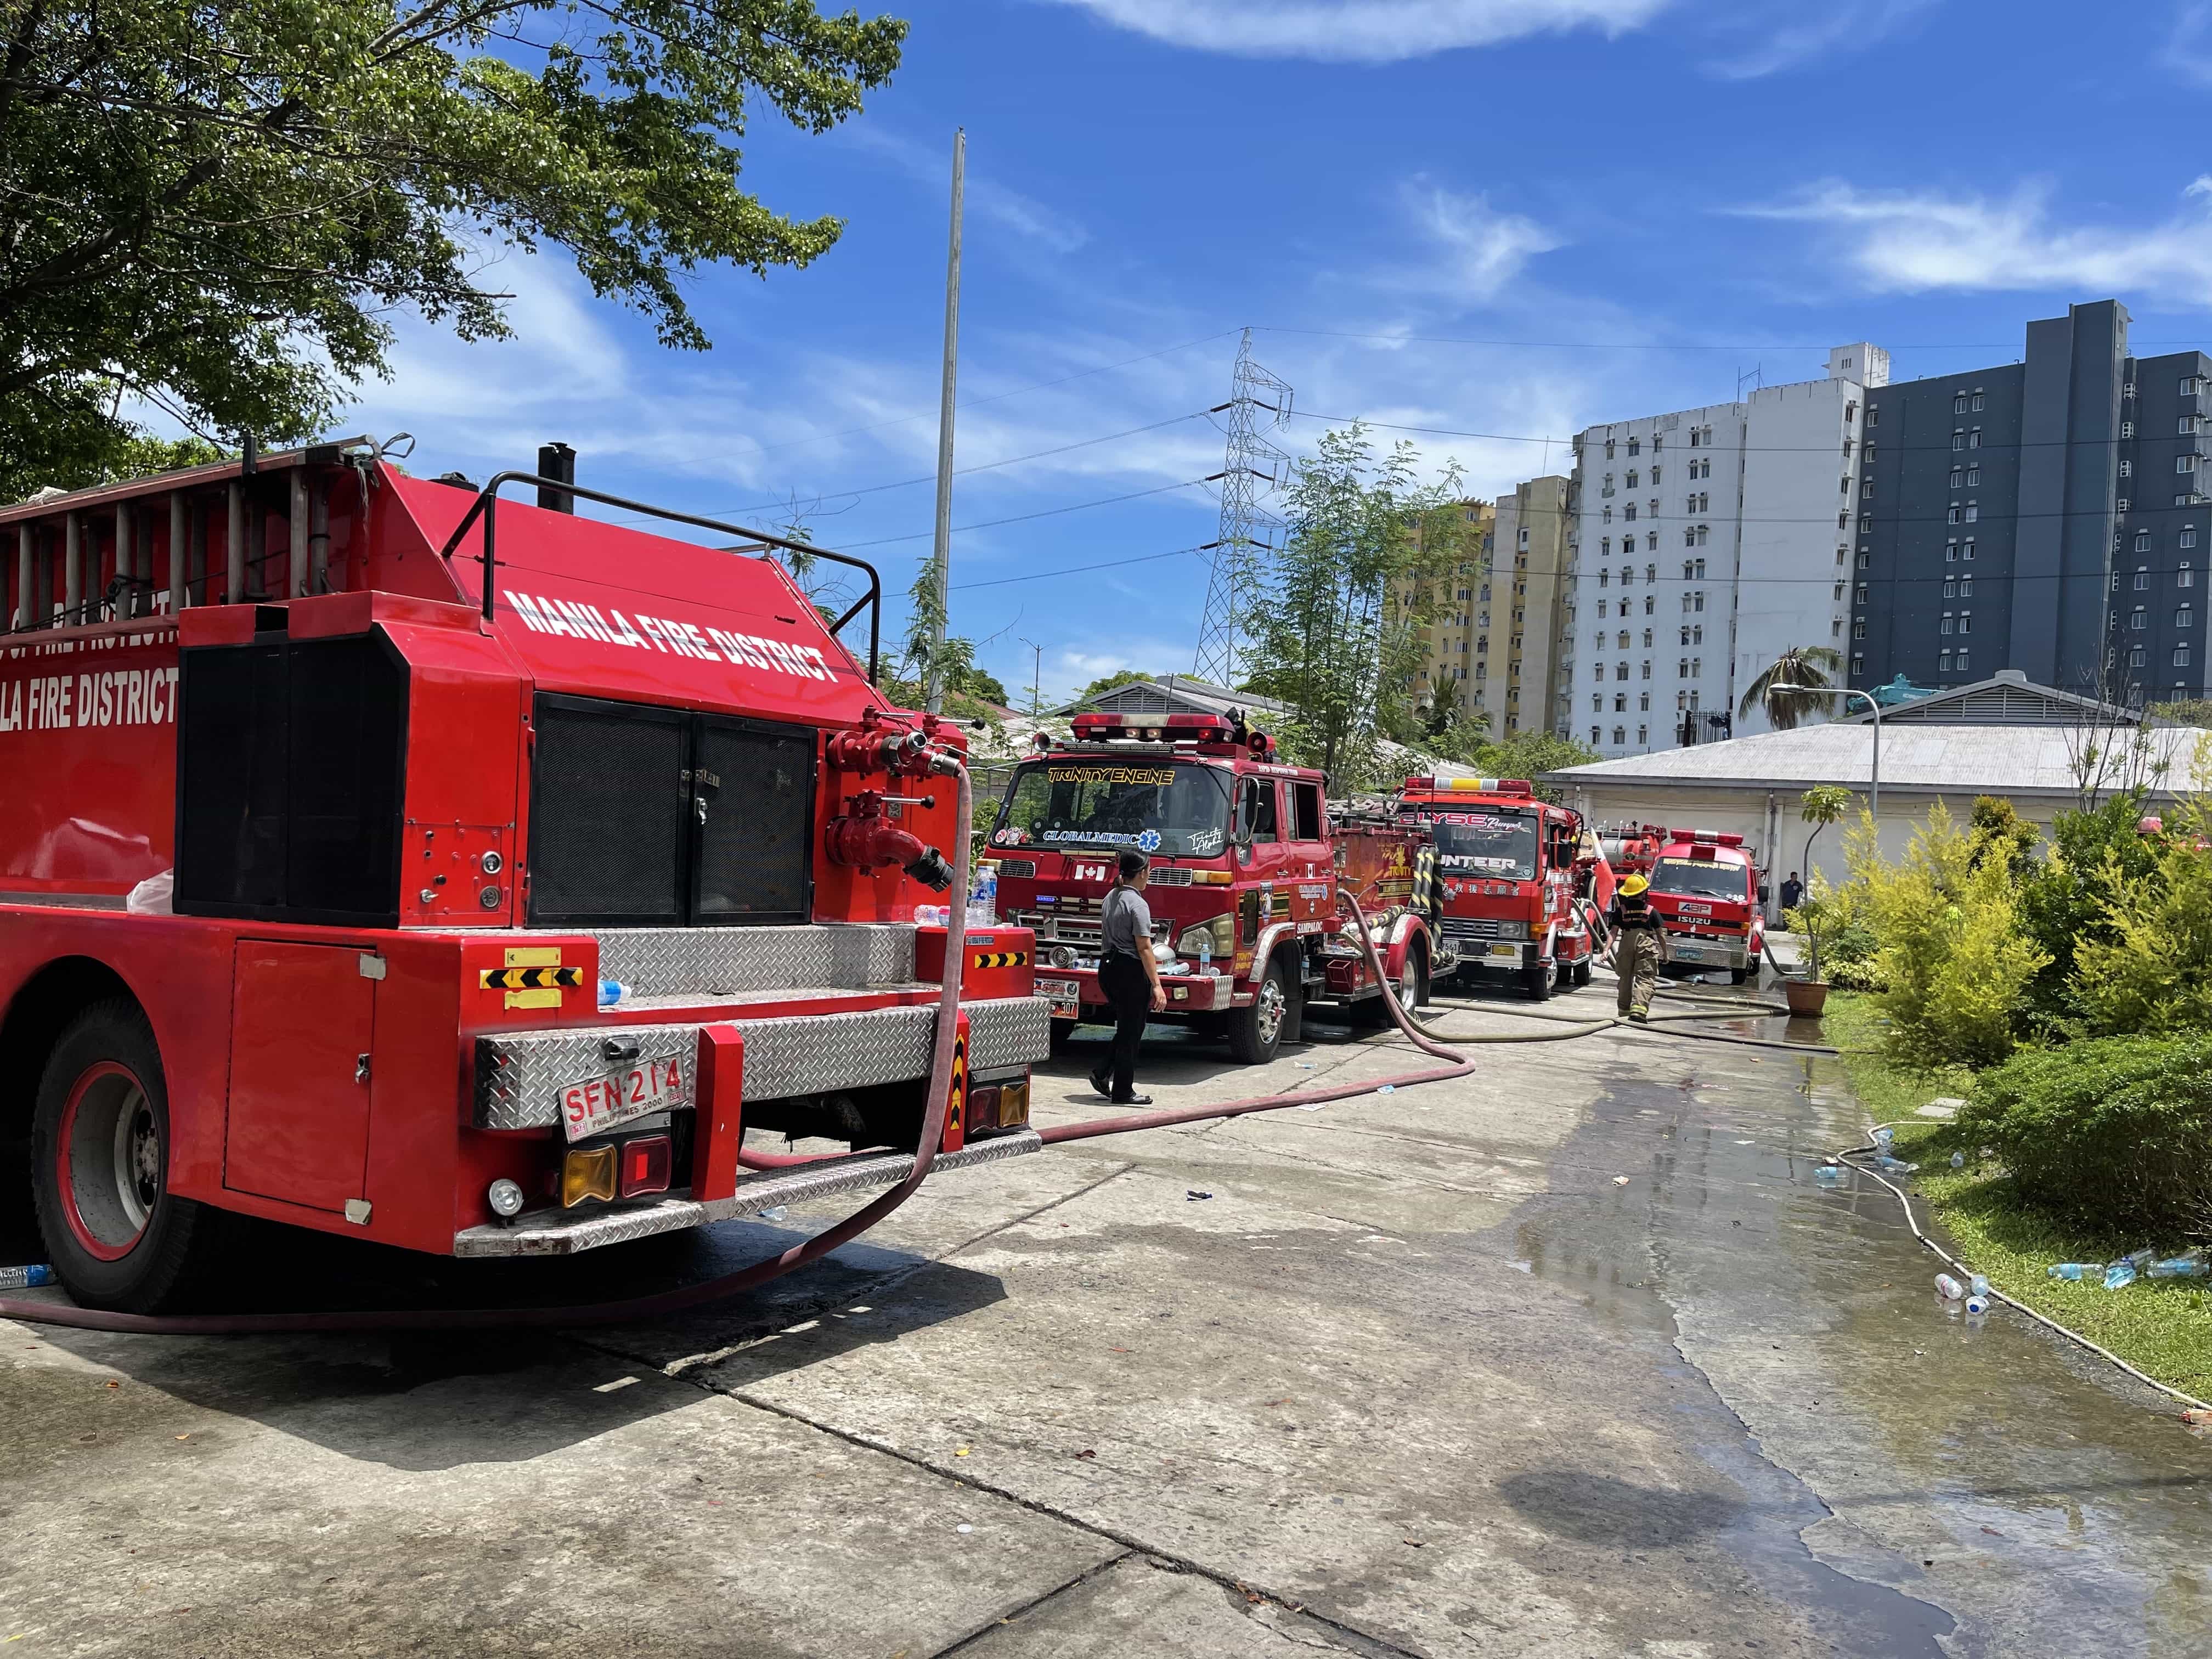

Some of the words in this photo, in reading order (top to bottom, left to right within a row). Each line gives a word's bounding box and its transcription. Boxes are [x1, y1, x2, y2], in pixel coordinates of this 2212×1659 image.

[503, 590, 651, 650] MANILA
[634, 614, 722, 662] FIRE
[706, 627, 838, 683] DISTRICT
[27, 675, 73, 730] FIRE
[77, 667, 179, 727] DISTRICT
[1048, 766, 1112, 783] TRINITY
[1110, 766, 1176, 786] ENGINE
[1042, 830, 1141, 845] GLOBALMEDIC
[1187, 827, 1223, 847] Trinity
[1192, 837, 1223, 855] Alpha
[1680, 904, 1709, 913] ABP
[1297, 922, 1323, 934] SAMPALOC
[1678, 915, 1711, 925] ISUZU
[1062, 1002, 1075, 1015] 307
[592, 1104, 640, 1128] PHILIPNES
[642, 1097, 663, 1111] 2000
